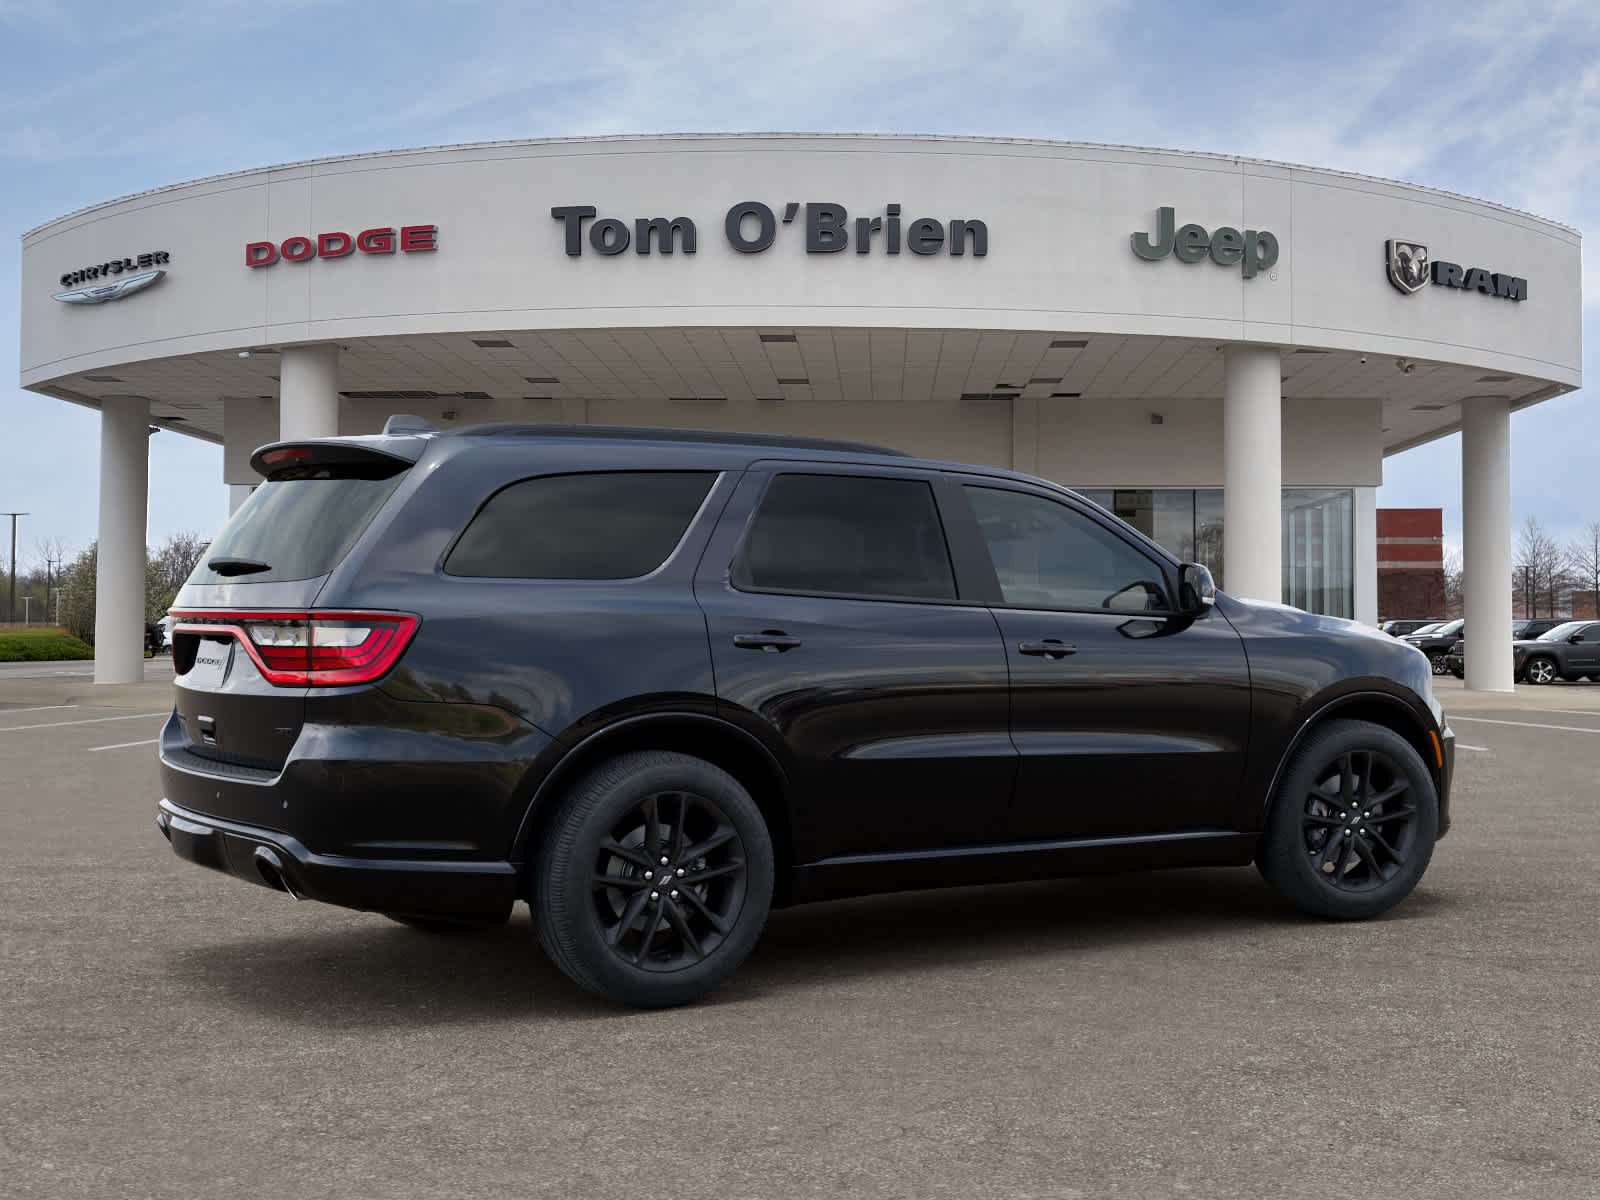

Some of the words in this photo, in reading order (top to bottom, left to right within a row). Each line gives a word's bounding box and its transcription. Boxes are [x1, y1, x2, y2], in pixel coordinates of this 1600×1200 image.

[245, 225, 437, 268] DODGE
[551, 205, 697, 255] Tom
[725, 201, 988, 255] O'Brien
[1131, 207, 1279, 279] Jeep
[60, 251, 169, 286] CHRYSLER
[1431, 261, 1527, 301] RAM
